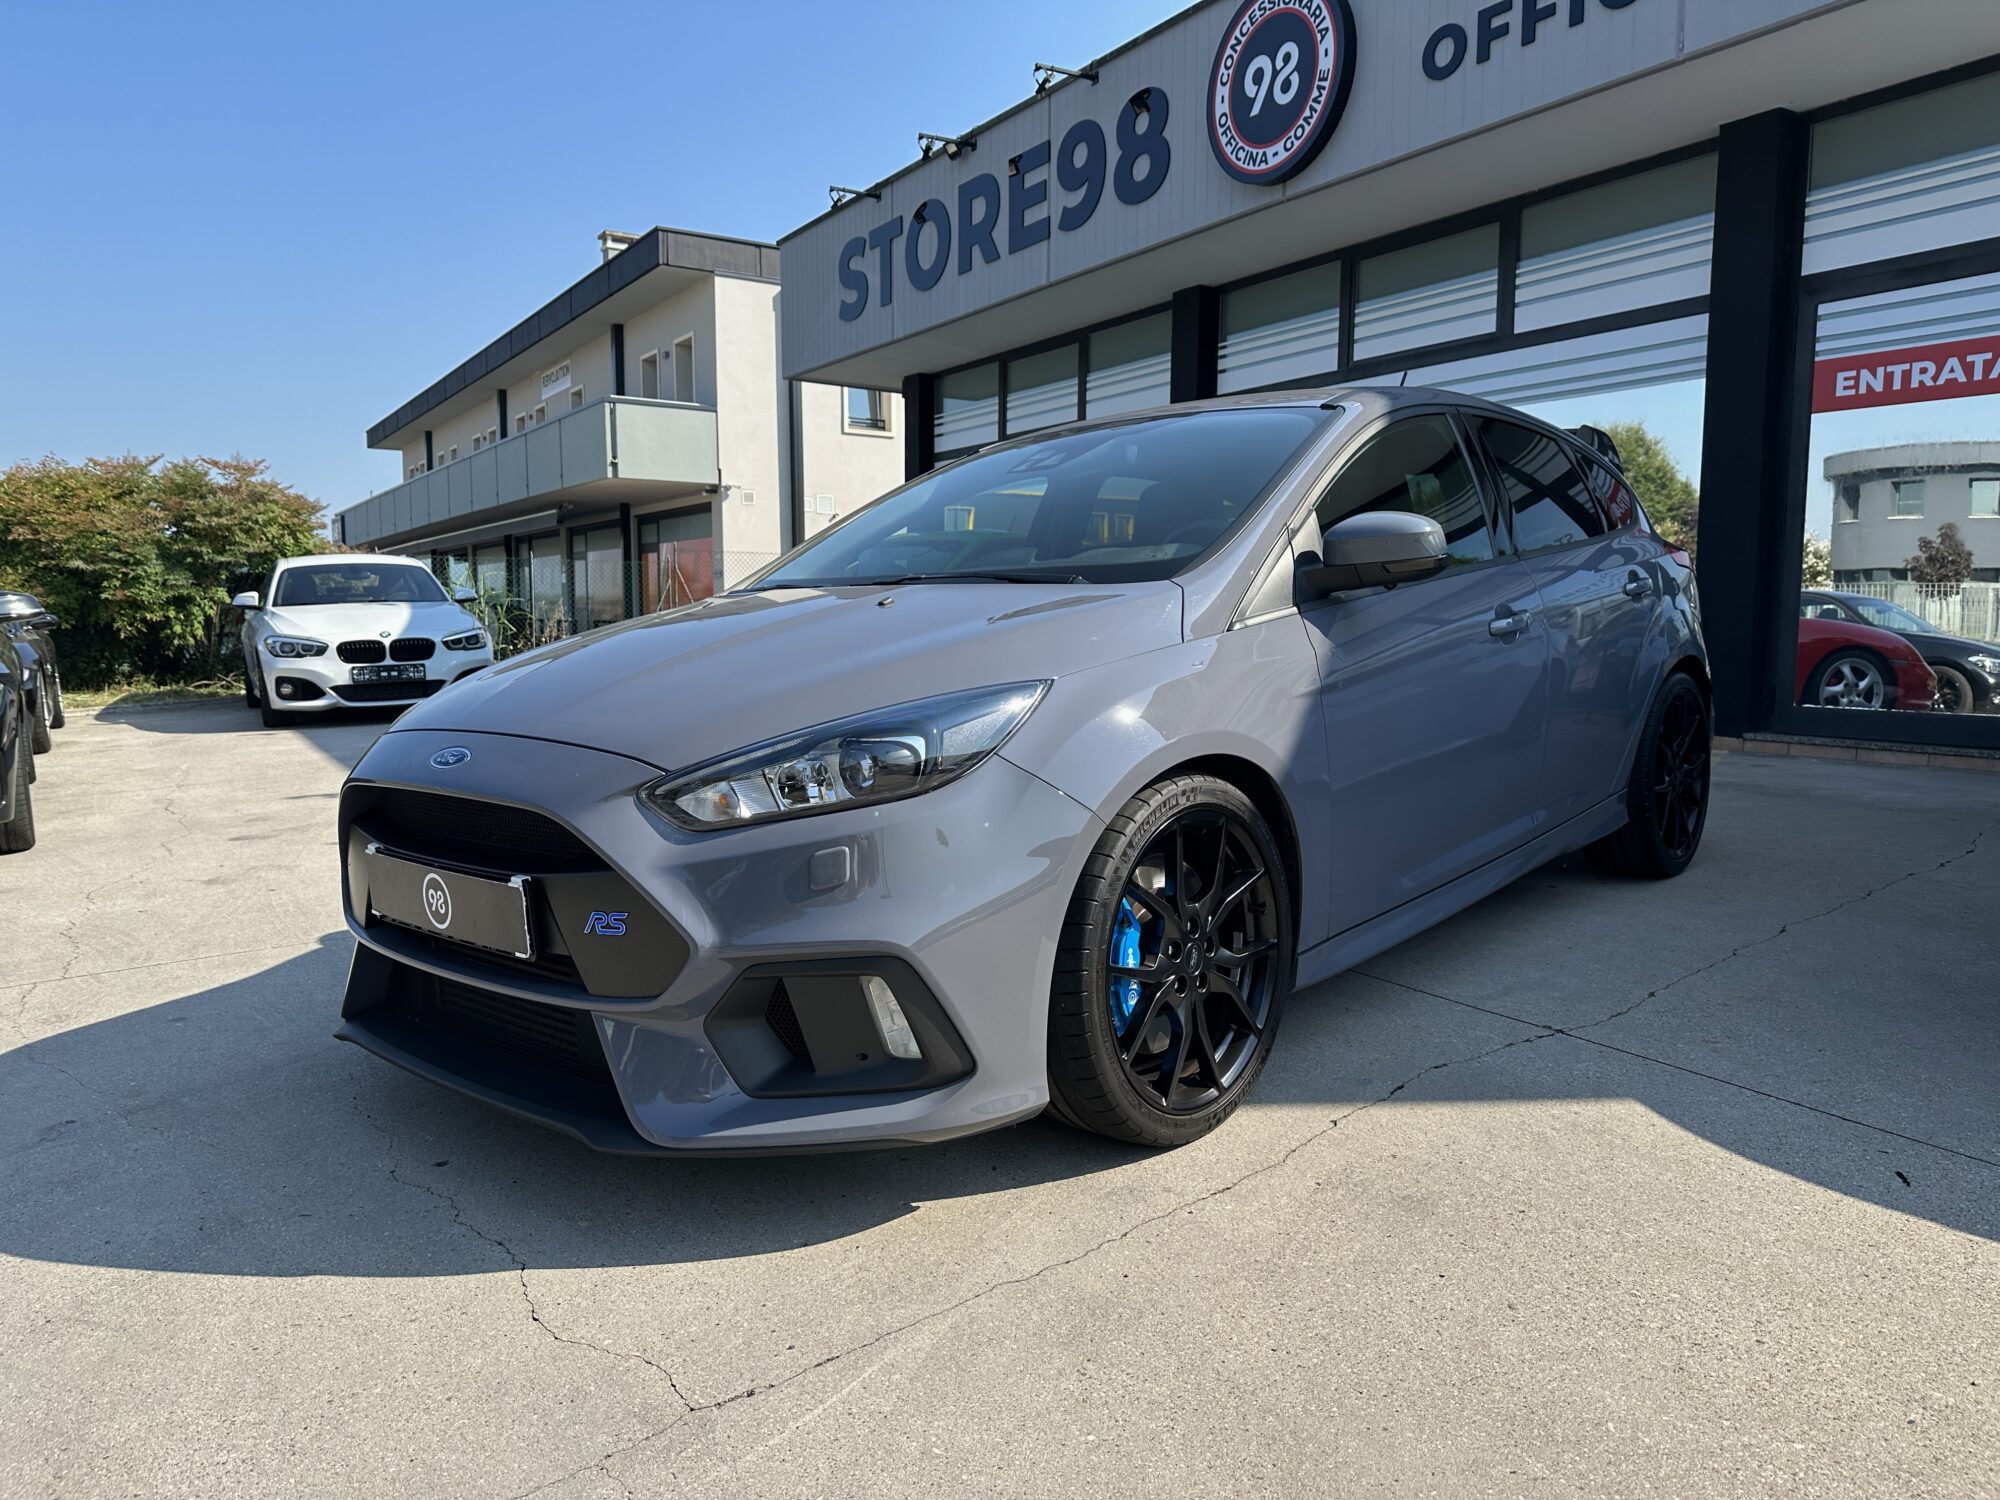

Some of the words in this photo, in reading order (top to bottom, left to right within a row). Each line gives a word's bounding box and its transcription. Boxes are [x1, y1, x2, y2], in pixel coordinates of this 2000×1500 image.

[1422, 0, 1636, 81] OFF
[1244, 41, 1299, 117] 98
[1283, 68, 1330, 152] GOMME
[1218, 112, 1268, 167] OFFICINA
[838, 86, 1171, 322] STORE98
[1132, 793, 1180, 847] MICHELIN
[428, 888, 445, 914] 98
[584, 911, 629, 936] RS
